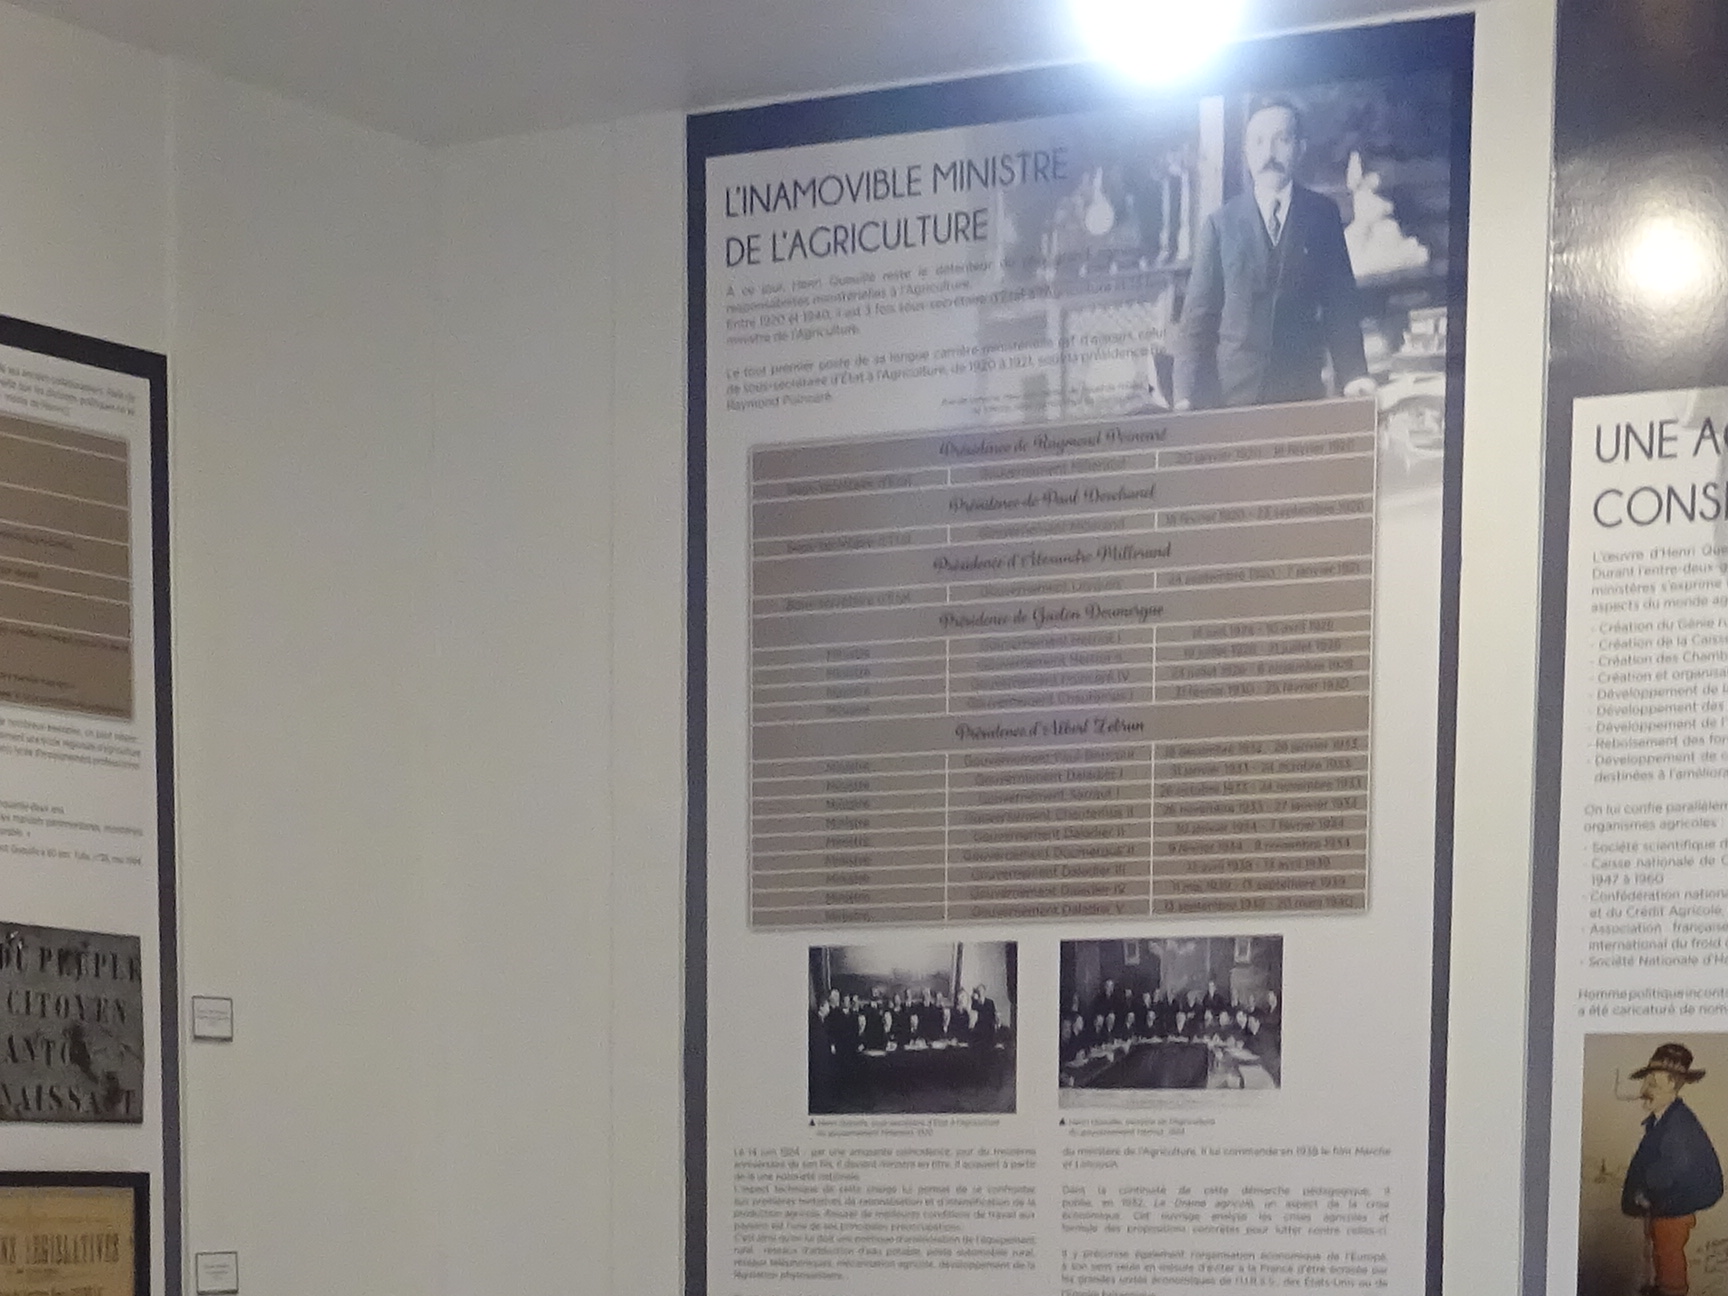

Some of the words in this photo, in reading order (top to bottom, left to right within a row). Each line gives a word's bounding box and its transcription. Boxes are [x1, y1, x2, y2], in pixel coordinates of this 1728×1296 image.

[726, 164, 922, 218] L'INAMOVIBLE
[932, 148, 1069, 194] MINISTRE
[726, 235, 761, 268] DE
[771, 208, 989, 262] L'AGRICULTURE
[1595, 419, 1678, 463] UNE
